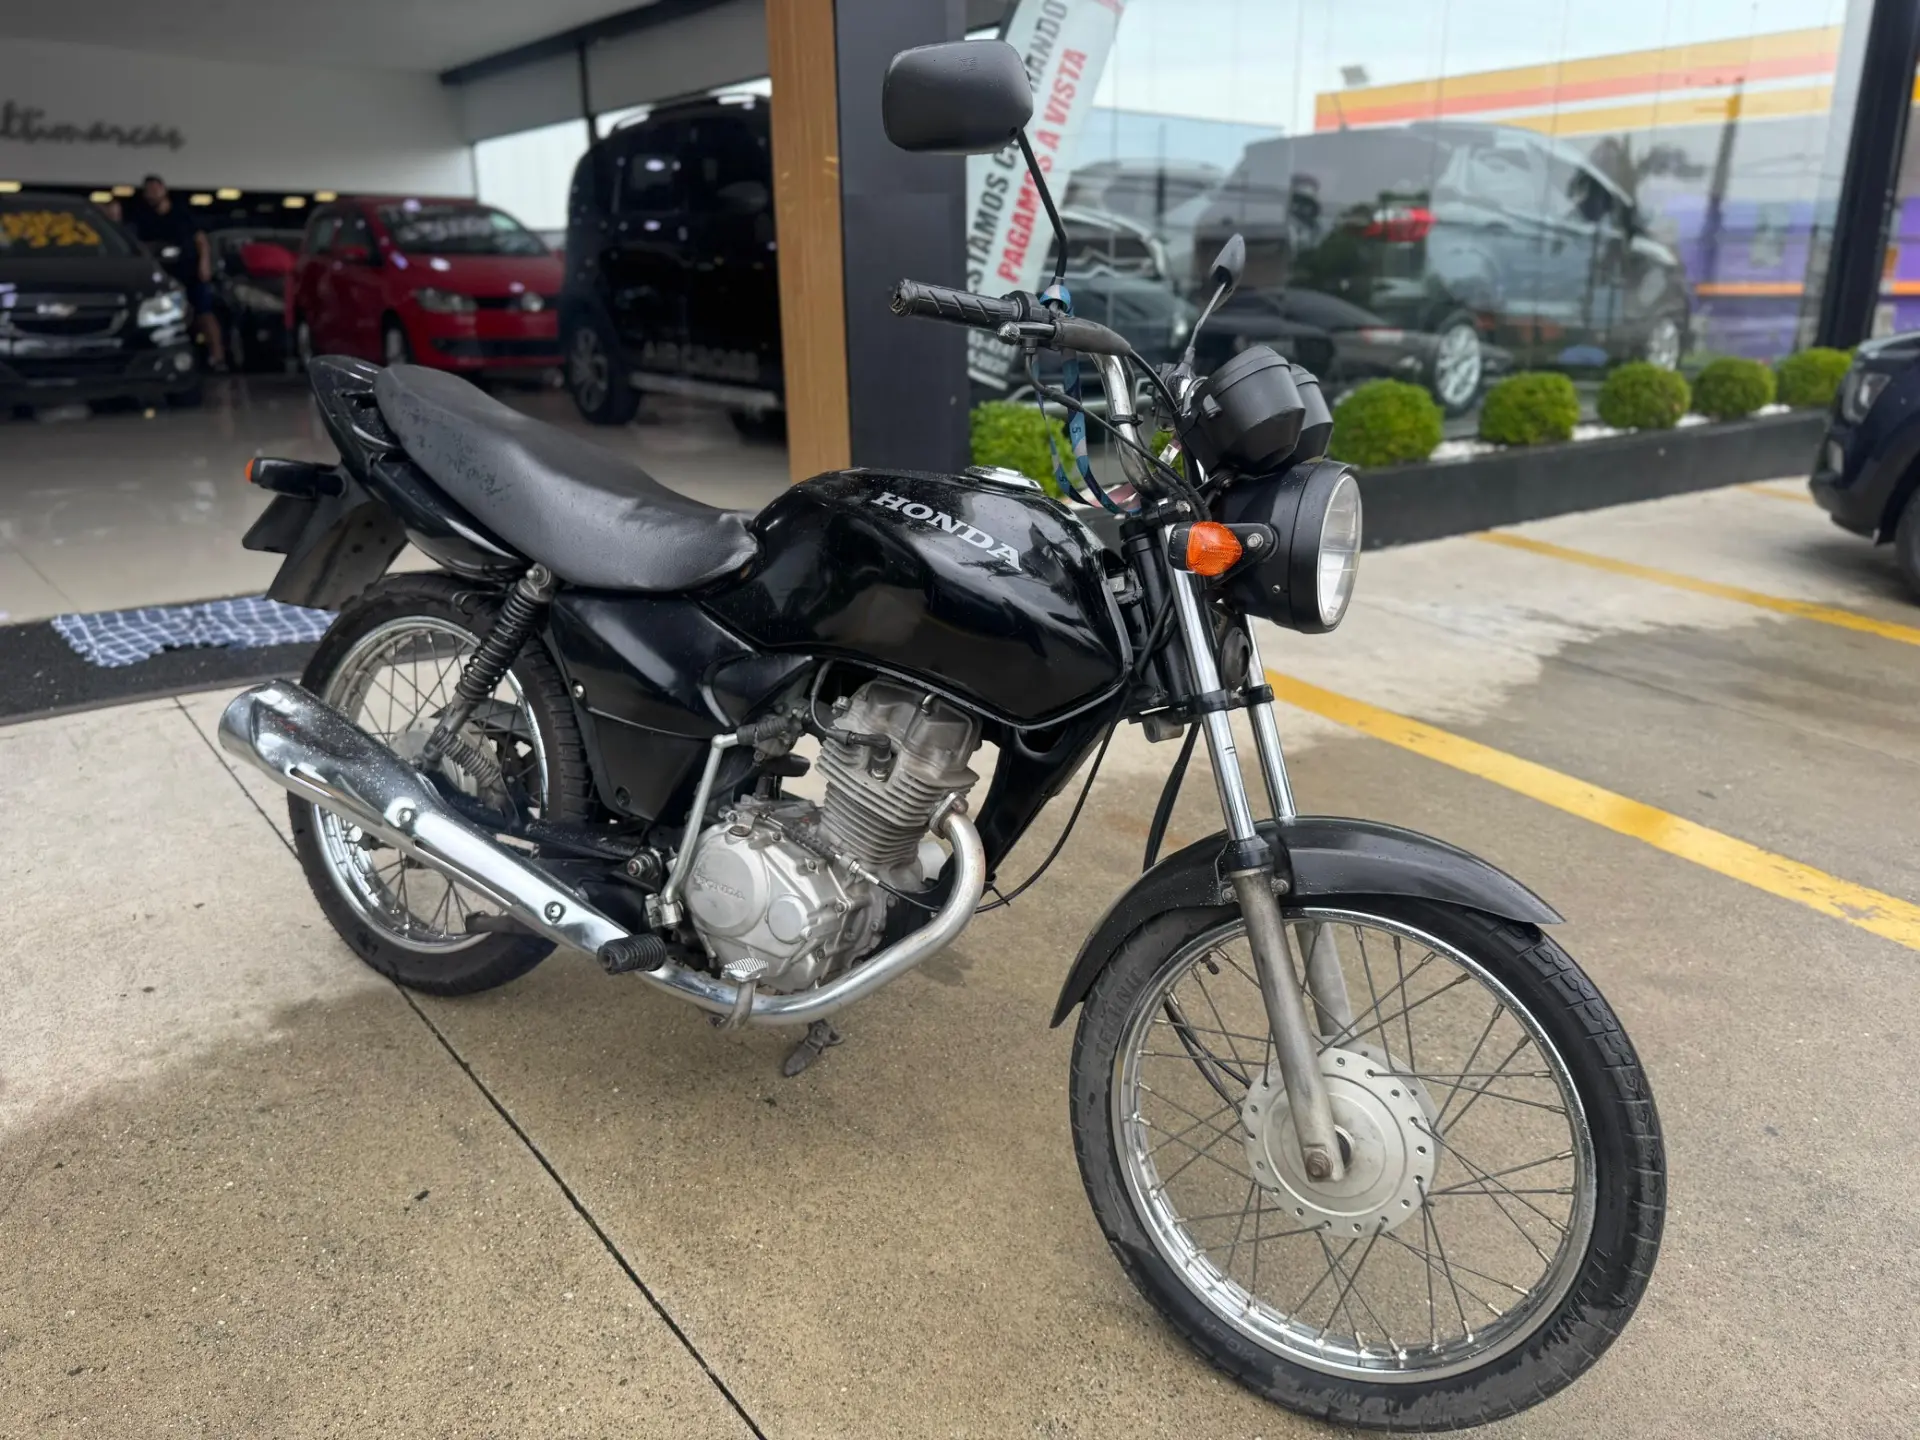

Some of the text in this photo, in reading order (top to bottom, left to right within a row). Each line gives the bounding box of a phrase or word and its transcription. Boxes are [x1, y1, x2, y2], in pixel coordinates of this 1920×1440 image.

[1043, 48, 1087, 126] VISTA
[967, 172, 1009, 293] STAMOS
[871, 491, 1023, 572] HONDA
